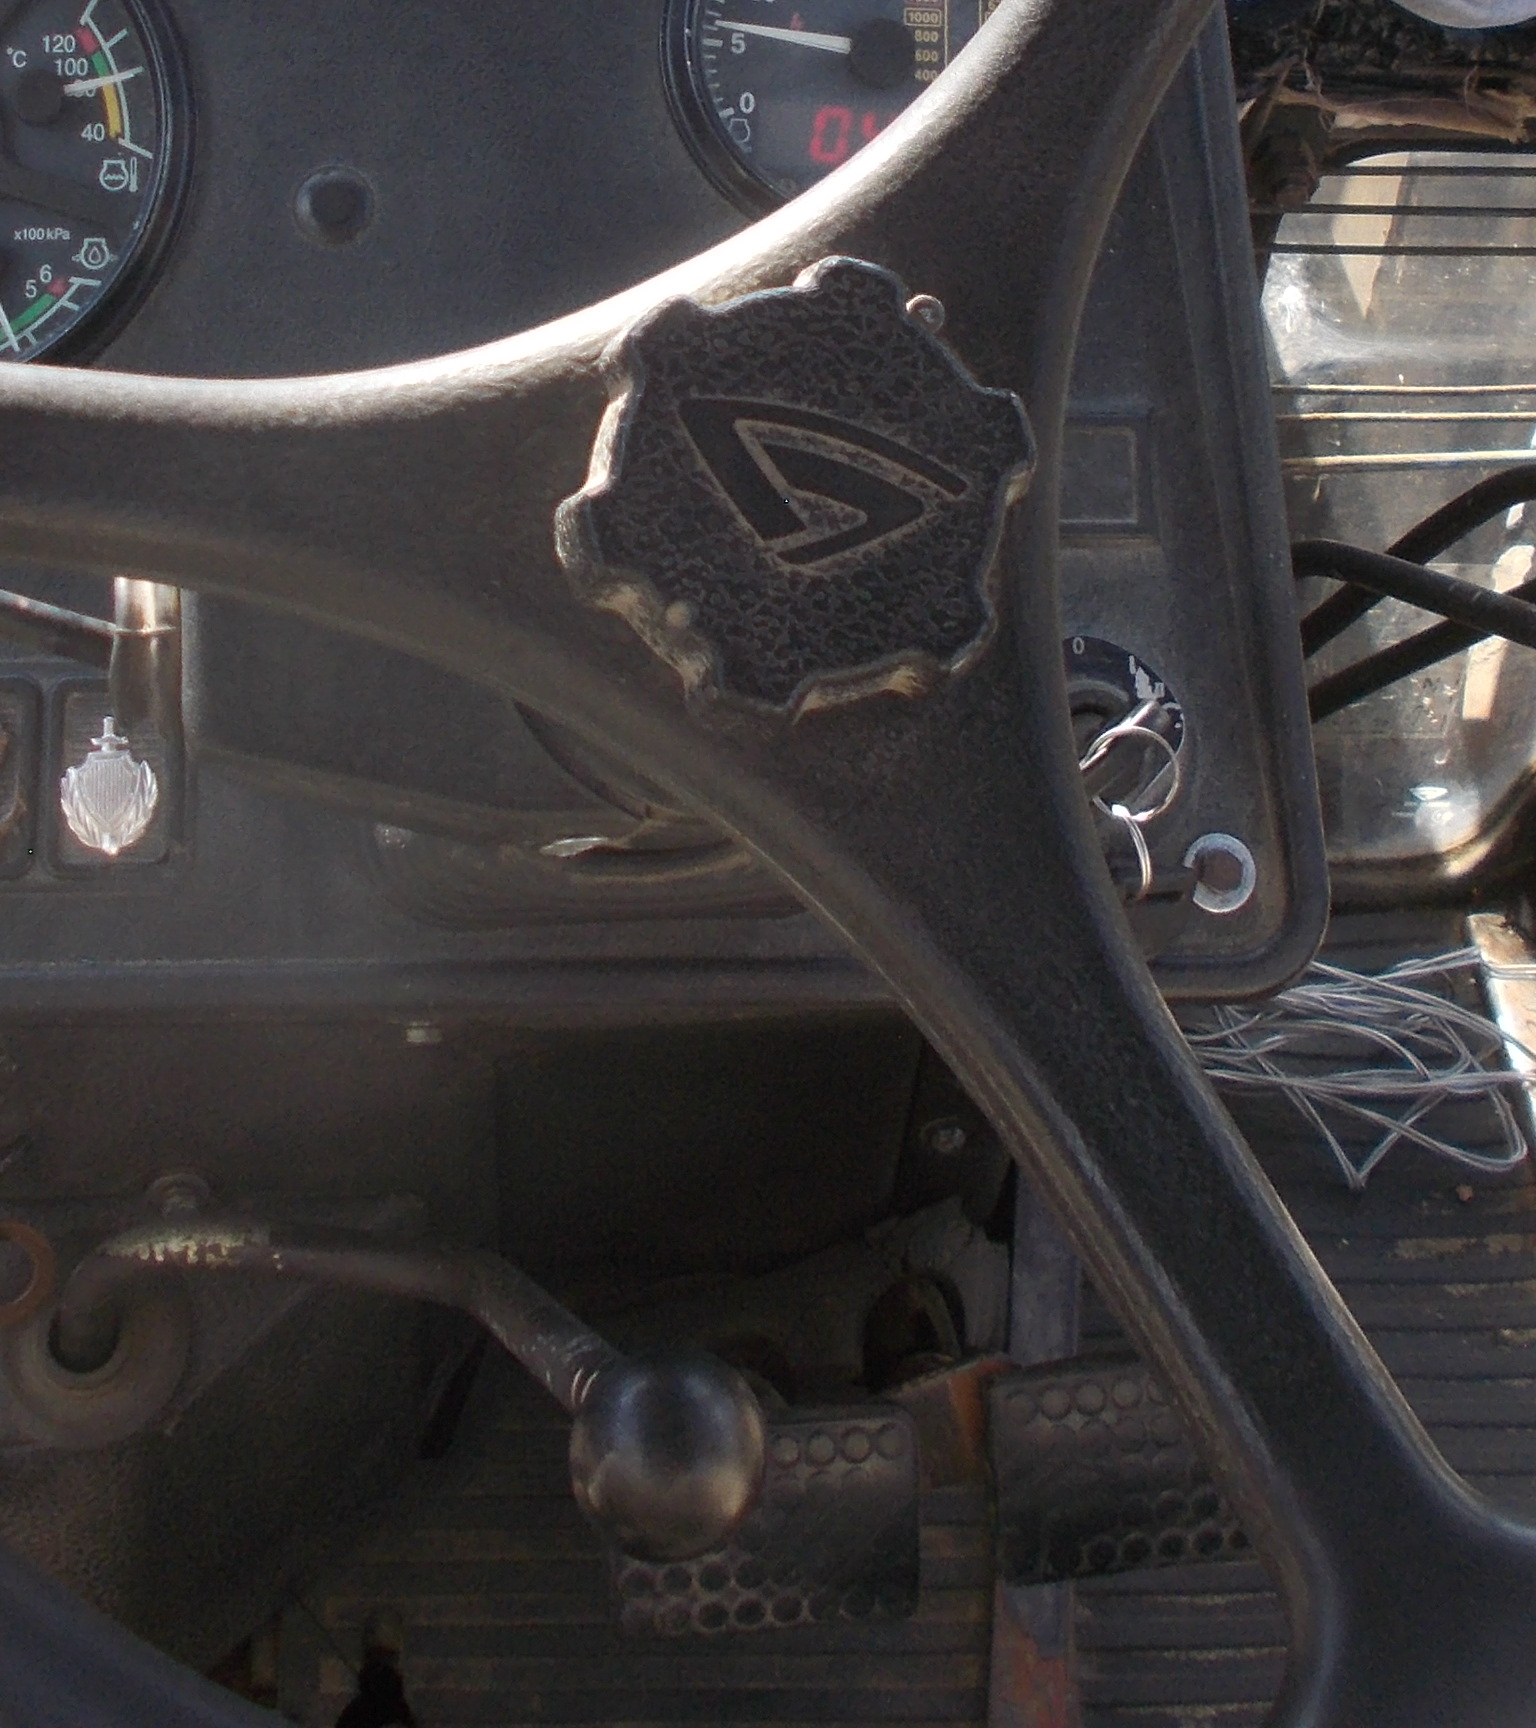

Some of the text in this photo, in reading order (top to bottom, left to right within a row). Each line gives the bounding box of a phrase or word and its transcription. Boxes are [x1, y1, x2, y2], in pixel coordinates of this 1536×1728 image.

[908, 11, 939, 24] 1000
[42, 34, 76, 53] 120
[730, 32, 746, 54] 5
[54, 57, 89, 76] 100
[739, 91, 756, 114] 0
[80, 122, 106, 142] 40
[39, 263, 53, 284] 6
[24, 279, 37, 298] 5
[1071, 636, 1085, 655] 0
